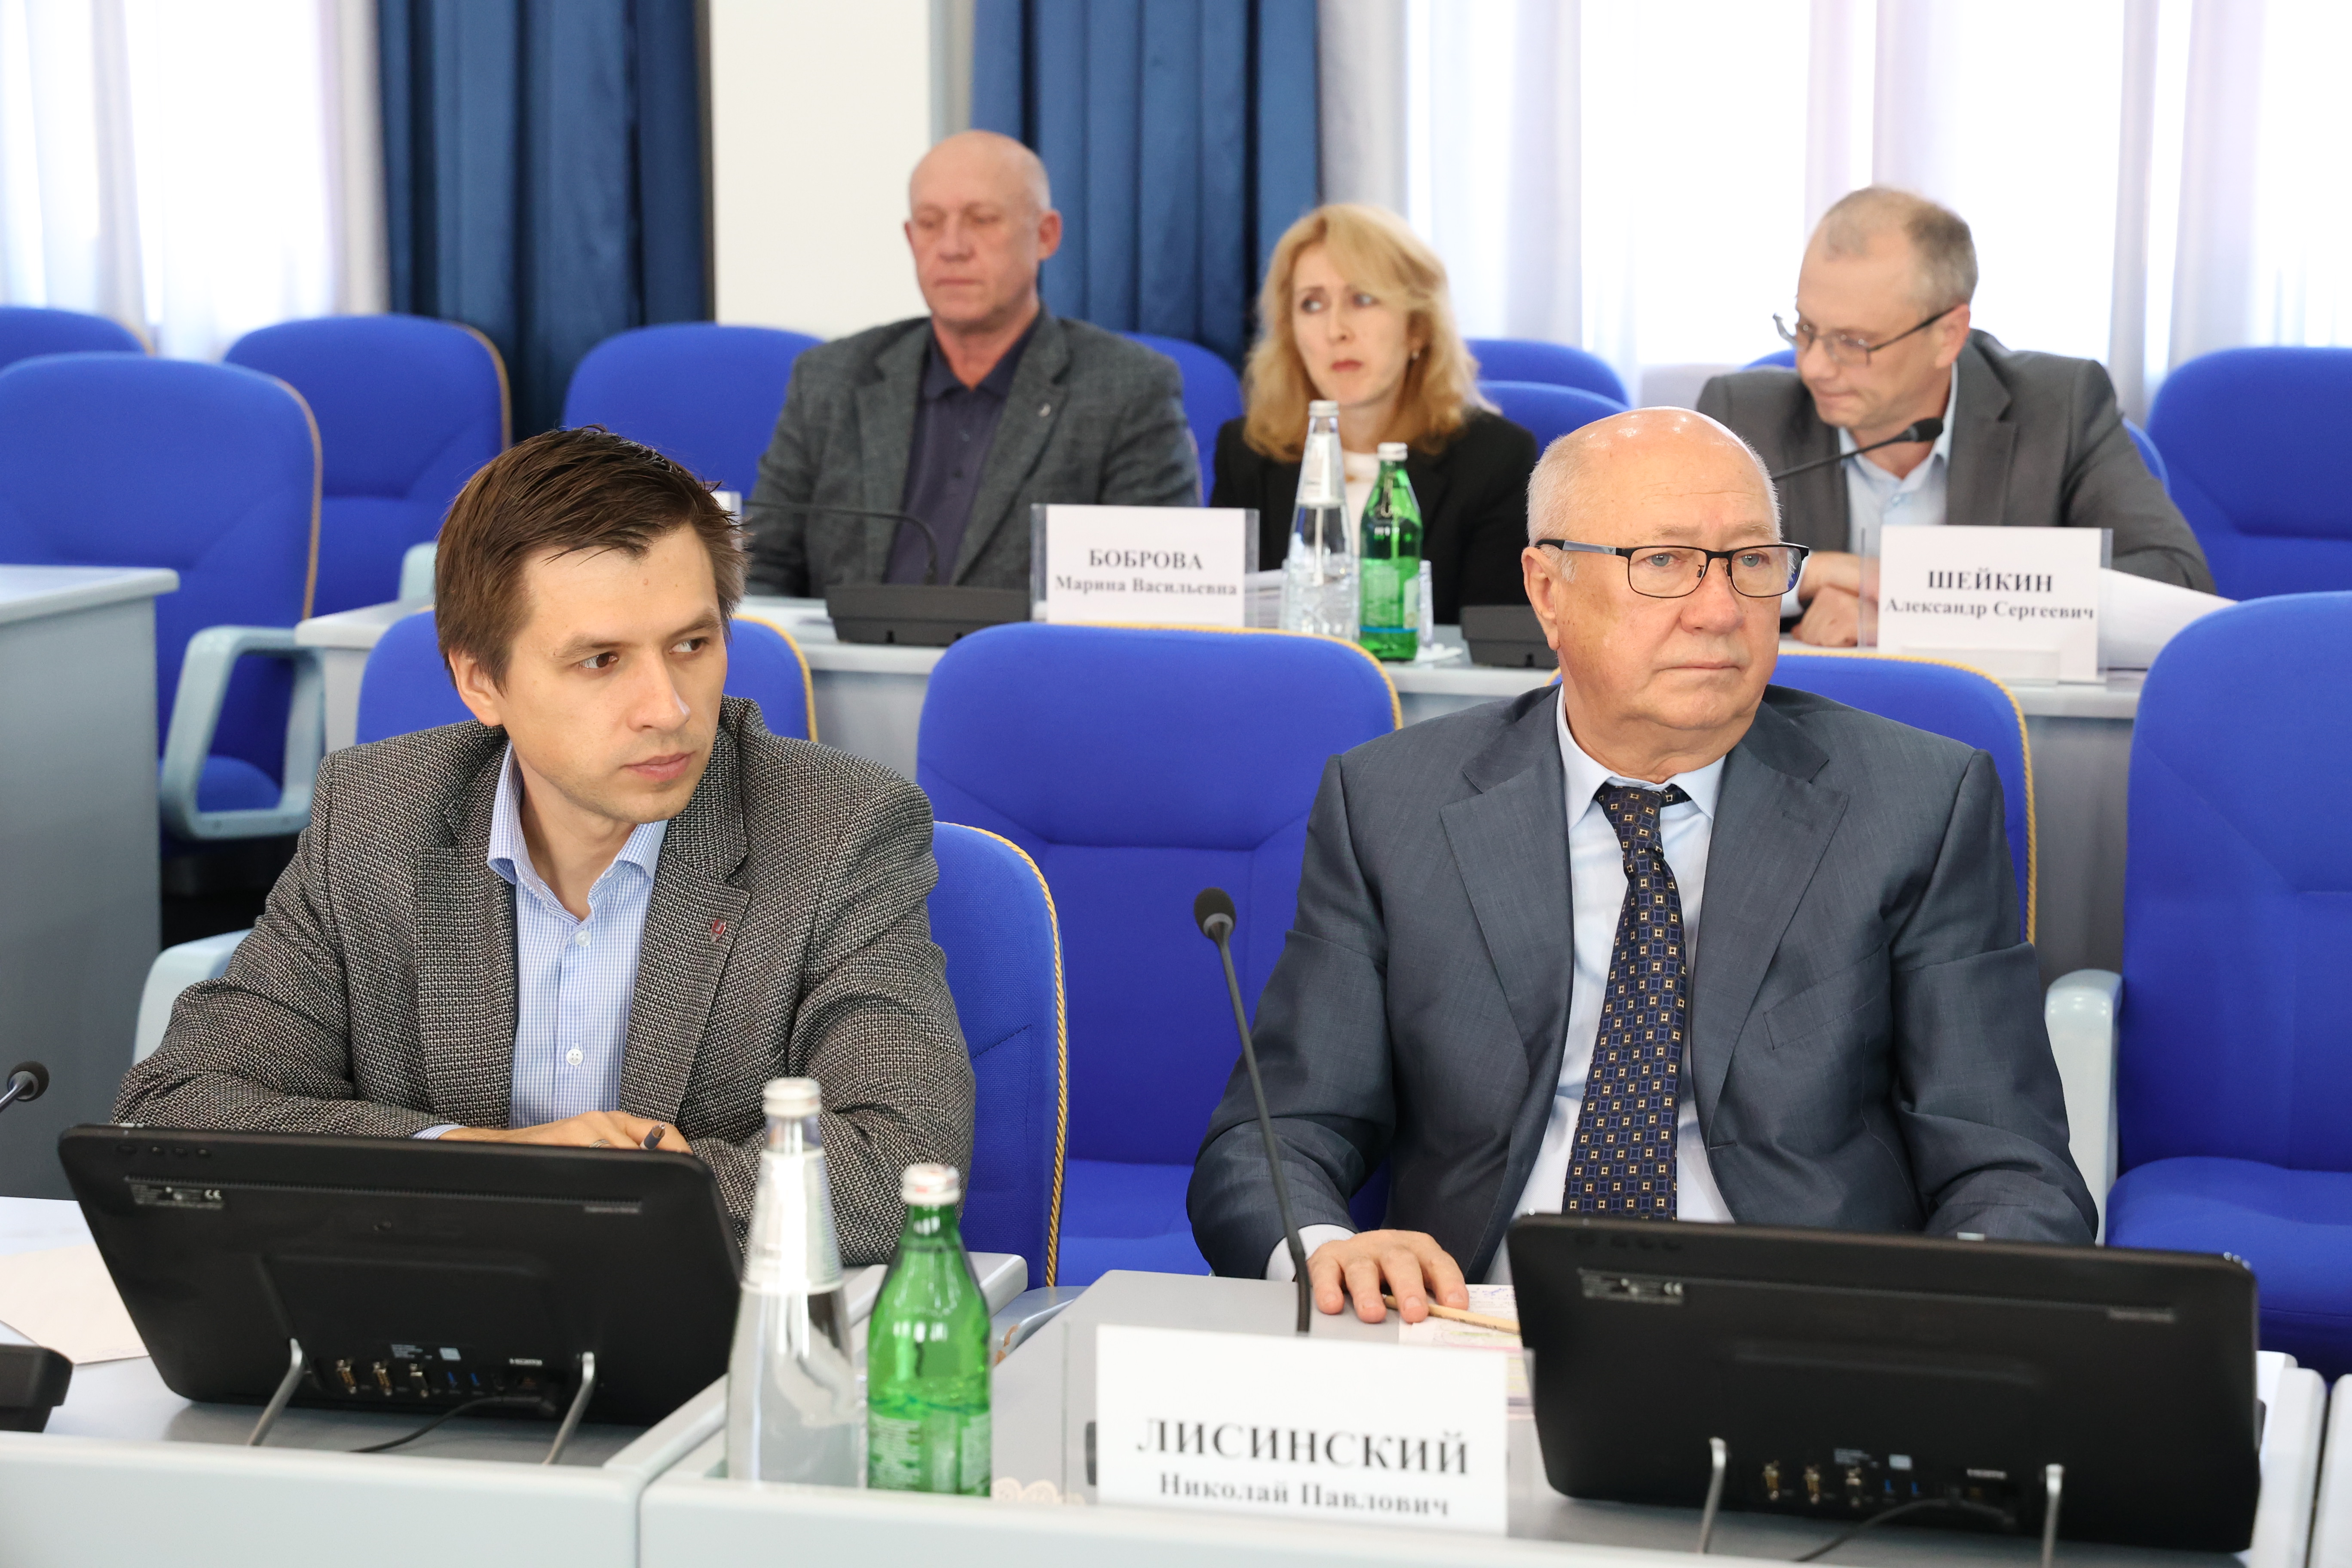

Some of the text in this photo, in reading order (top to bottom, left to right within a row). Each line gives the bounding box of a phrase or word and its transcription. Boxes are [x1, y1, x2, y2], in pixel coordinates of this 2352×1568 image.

[1089, 548, 1203, 570] БОБРОВА
[1056, 575, 1237, 596] Марина Васильевна
[1927, 568, 2053, 593] ШЕЙКИН
[1885, 598, 2094, 620] Александр Сергеевич
[1137, 1418, 1468, 1475] ЛИСИНСКИЙ
[1160, 1471, 1449, 1516] Николай Павлович
